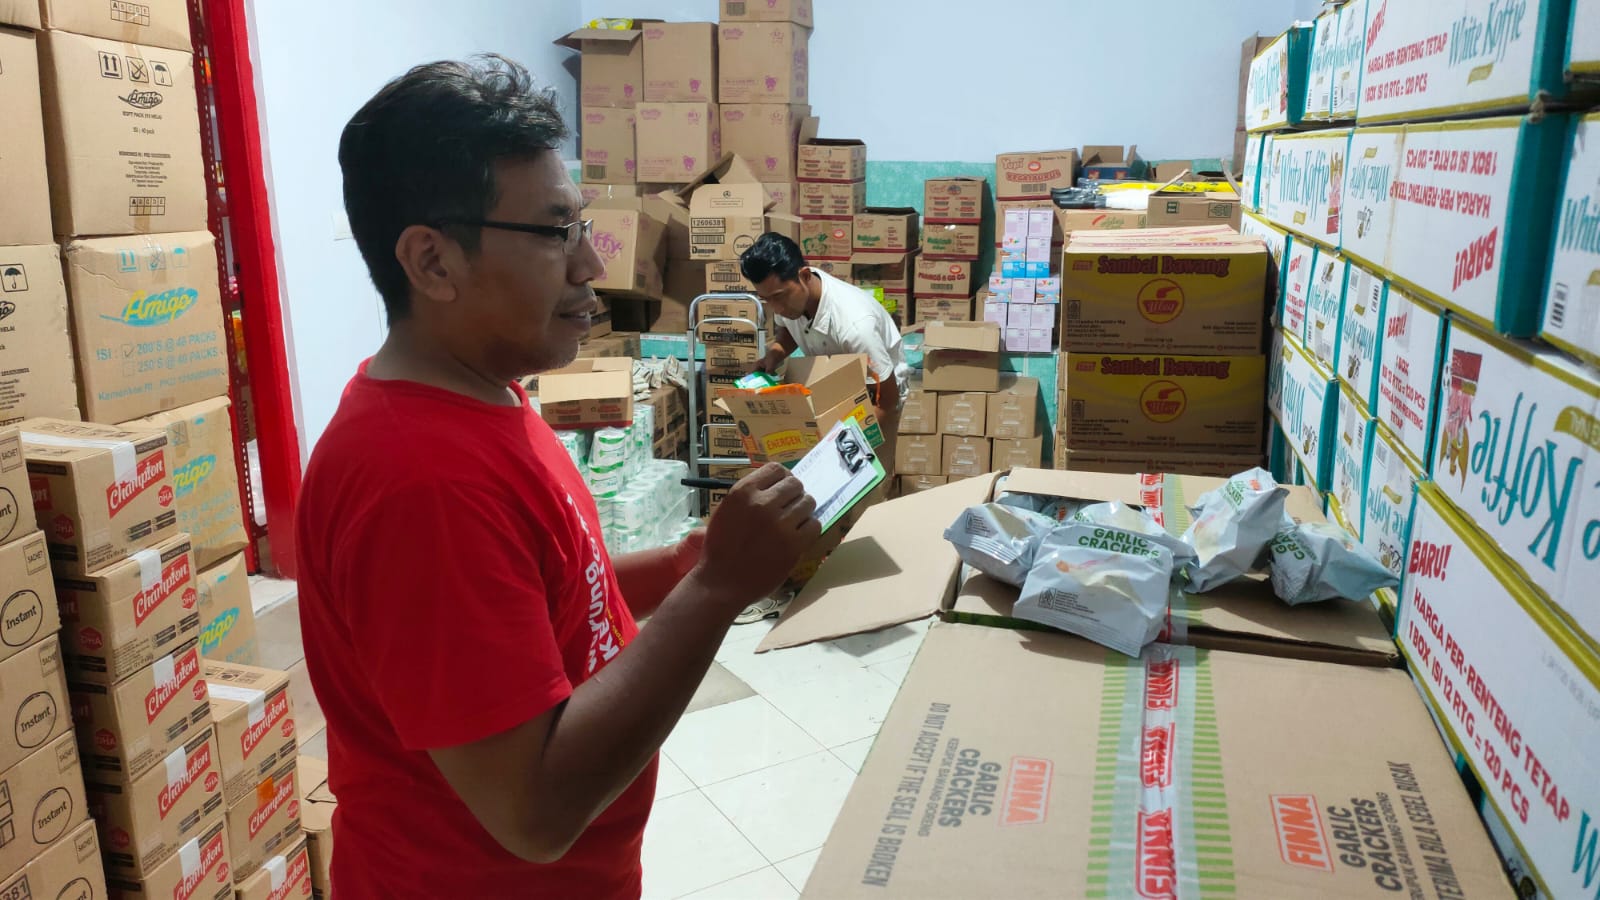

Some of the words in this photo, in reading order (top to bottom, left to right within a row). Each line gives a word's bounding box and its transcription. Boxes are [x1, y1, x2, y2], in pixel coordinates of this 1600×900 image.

[1425, 32, 1448, 57] TETAP
[1449, 16, 1482, 69] White
[1482, 0, 1526, 63] Koffie
[1389, 79, 1401, 98] RTG
[1415, 73, 1428, 93] PCS
[1002, 157, 1025, 170] Yupi
[1406, 149, 1419, 168] PCS
[1417, 149, 1428, 169] 120
[1433, 150, 1450, 171] RTG
[1449, 151, 1459, 171] 12
[1458, 151, 1470, 172] ISI
[1470, 151, 1493, 176] BOX
[1279, 150, 1302, 203] White
[1301, 149, 1330, 222] Koffie
[1456, 190, 1492, 218] HARGA
[1098, 255, 1159, 275] Sambal
[1162, 256, 1231, 278] Bawang
[1452, 226, 1498, 293] BARU!
[124, 289, 193, 323] Amigo
[1387, 312, 1408, 338] BARU!
[1101, 357, 1161, 376] Sambal
[1163, 358, 1231, 379] Bawang
[1414, 389, 1426, 411] PCS
[767, 436, 800, 451] ENERGEN
[109, 459, 165, 510] Champion
[174, 459, 210, 493] migo
[1471, 391, 1585, 572] Koffie
[159, 489, 174, 504] DHA
[1078, 535, 1160, 558] CRACKERS
[1093, 528, 1148, 548] GARLIC
[1408, 540, 1452, 582] BARU!
[137, 563, 189, 617] Champion
[182, 593, 197, 607] DHA
[6, 604, 38, 630] Instant
[199, 613, 235, 646] migo
[148, 654, 197, 716] Champion
[20, 706, 51, 733] Instant
[929, 702, 951, 713] DO
[1413, 587, 1445, 649] HARGA
[1524, 744, 1570, 824] TETAP
[242, 695, 287, 751] Champion
[922, 714, 947, 730] NOT
[1411, 626, 1431, 668] BOX
[1430, 652, 1444, 686] ISI
[1442, 668, 1453, 703] 12
[1452, 684, 1475, 740] RTG
[1483, 737, 1502, 781] 120
[1501, 768, 1531, 825] PCS
[912, 731, 941, 764] ACCEPT
[160, 749, 210, 812] Champion
[905, 765, 929, 775] IF
[1387, 760, 1422, 794] RUSAK
[897, 776, 925, 795] THE
[938, 748, 981, 828] CRACKERS
[967, 762, 1002, 816] GARLIC
[1005, 759, 1048, 823] FINNA
[38, 801, 68, 829] Instant
[250, 779, 294, 834] Champion
[886, 795, 918, 821] SEAL
[1401, 793, 1436, 826] SEGEL
[881, 823, 907, 835] IS
[1277, 797, 1327, 868] FINNA
[1327, 806, 1367, 868] GARLIC
[1412, 826, 1447, 855] BILA
[1351, 798, 1403, 892] CRACKERS
[861, 837, 903, 887] BROKEN
